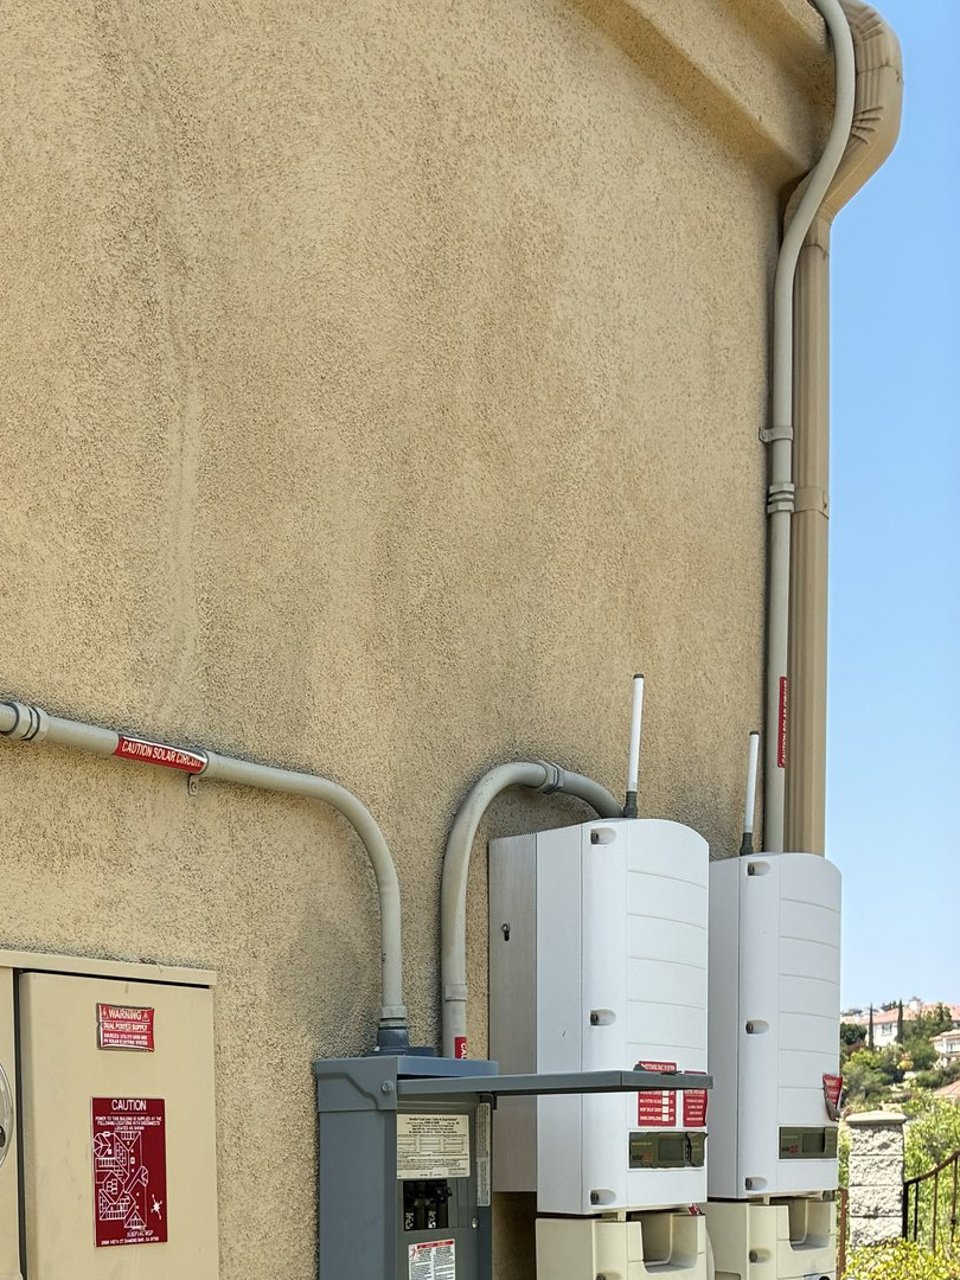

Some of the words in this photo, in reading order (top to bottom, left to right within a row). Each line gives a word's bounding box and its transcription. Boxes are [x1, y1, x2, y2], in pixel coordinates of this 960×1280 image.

[121, 741, 151, 757] CAUTION
[152, 747, 176, 762] SOLAR
[176, 753, 201, 767] CIRCUIT
[109, 1008, 141, 1020] WARNING
[111, 1099, 146, 1111] CAUTION
